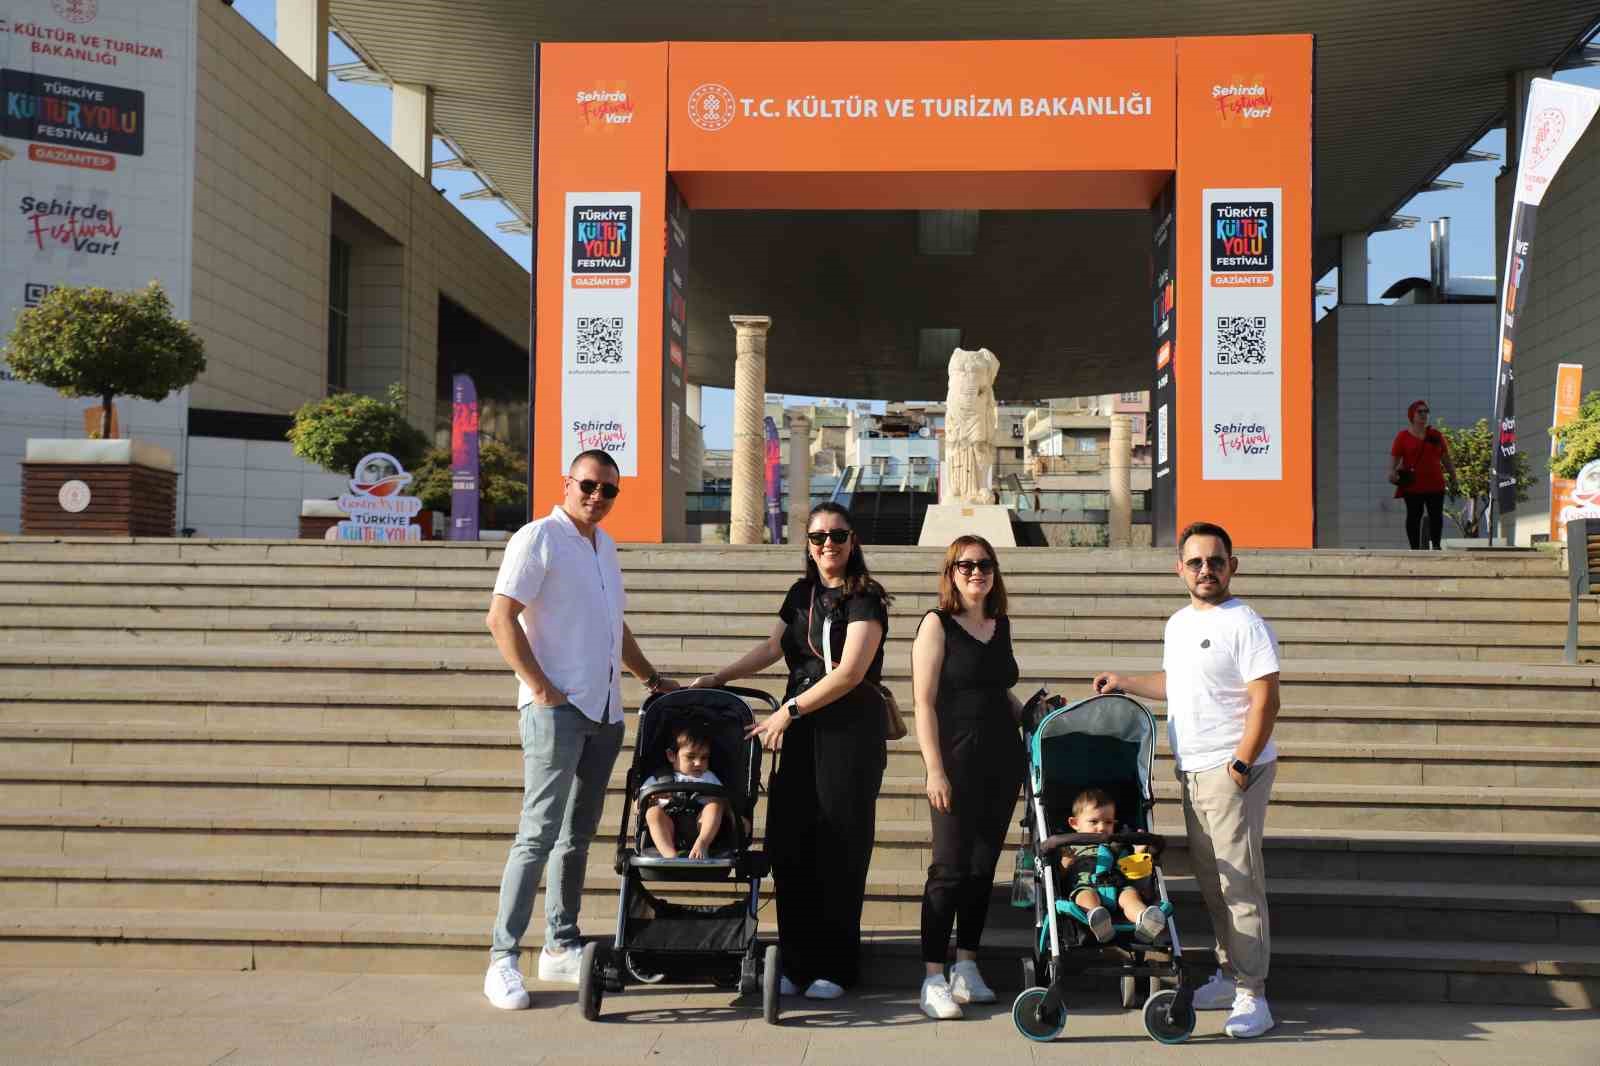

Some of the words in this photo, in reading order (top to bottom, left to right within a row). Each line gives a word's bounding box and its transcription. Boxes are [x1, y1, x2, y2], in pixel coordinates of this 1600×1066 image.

[14, 22, 76, 44] KÜLTÜR
[80, 34, 101, 49] VE
[103, 38, 164, 59] TURİZM
[43, 81, 105, 102] TÜRKİYE
[1211, 84, 1265, 98] Şehirde
[7, 92, 82, 129] KÜLTÜR
[82, 103, 137, 134] YOLU
[740, 98, 780, 118] T.C.
[786, 95, 879, 118] KÜLTÜR
[885, 98, 915, 118] VE
[921, 95, 1013, 117] TURİZM
[1020, 92, 1152, 117] BAKANLIĞI
[1242, 106, 1272, 119] Var!
[37, 124, 109, 145] FESTİVALİ
[20, 196, 109, 221] Şehirde
[578, 209, 627, 220] TÜRKİYE
[1216, 206, 1268, 218] TÜRKİYE
[577, 222, 627, 244] KÜLTÜR
[1216, 219, 1268, 242] KÜLTÜR
[73, 236, 120, 256] Var!
[584, 239, 622, 257] YOLU
[1223, 236, 1263, 256] YOLU
[577, 257, 626, 268] FESTİVALİ
[1216, 255, 1268, 266] FESTİVALİ
[573, 421, 620, 432] Şehirde
[1214, 423, 1264, 434] Şehirde
[600, 441, 626, 452] Var!
[1242, 443, 1270, 455] Var!
[355, 511, 406, 526] TÜRKİYE
